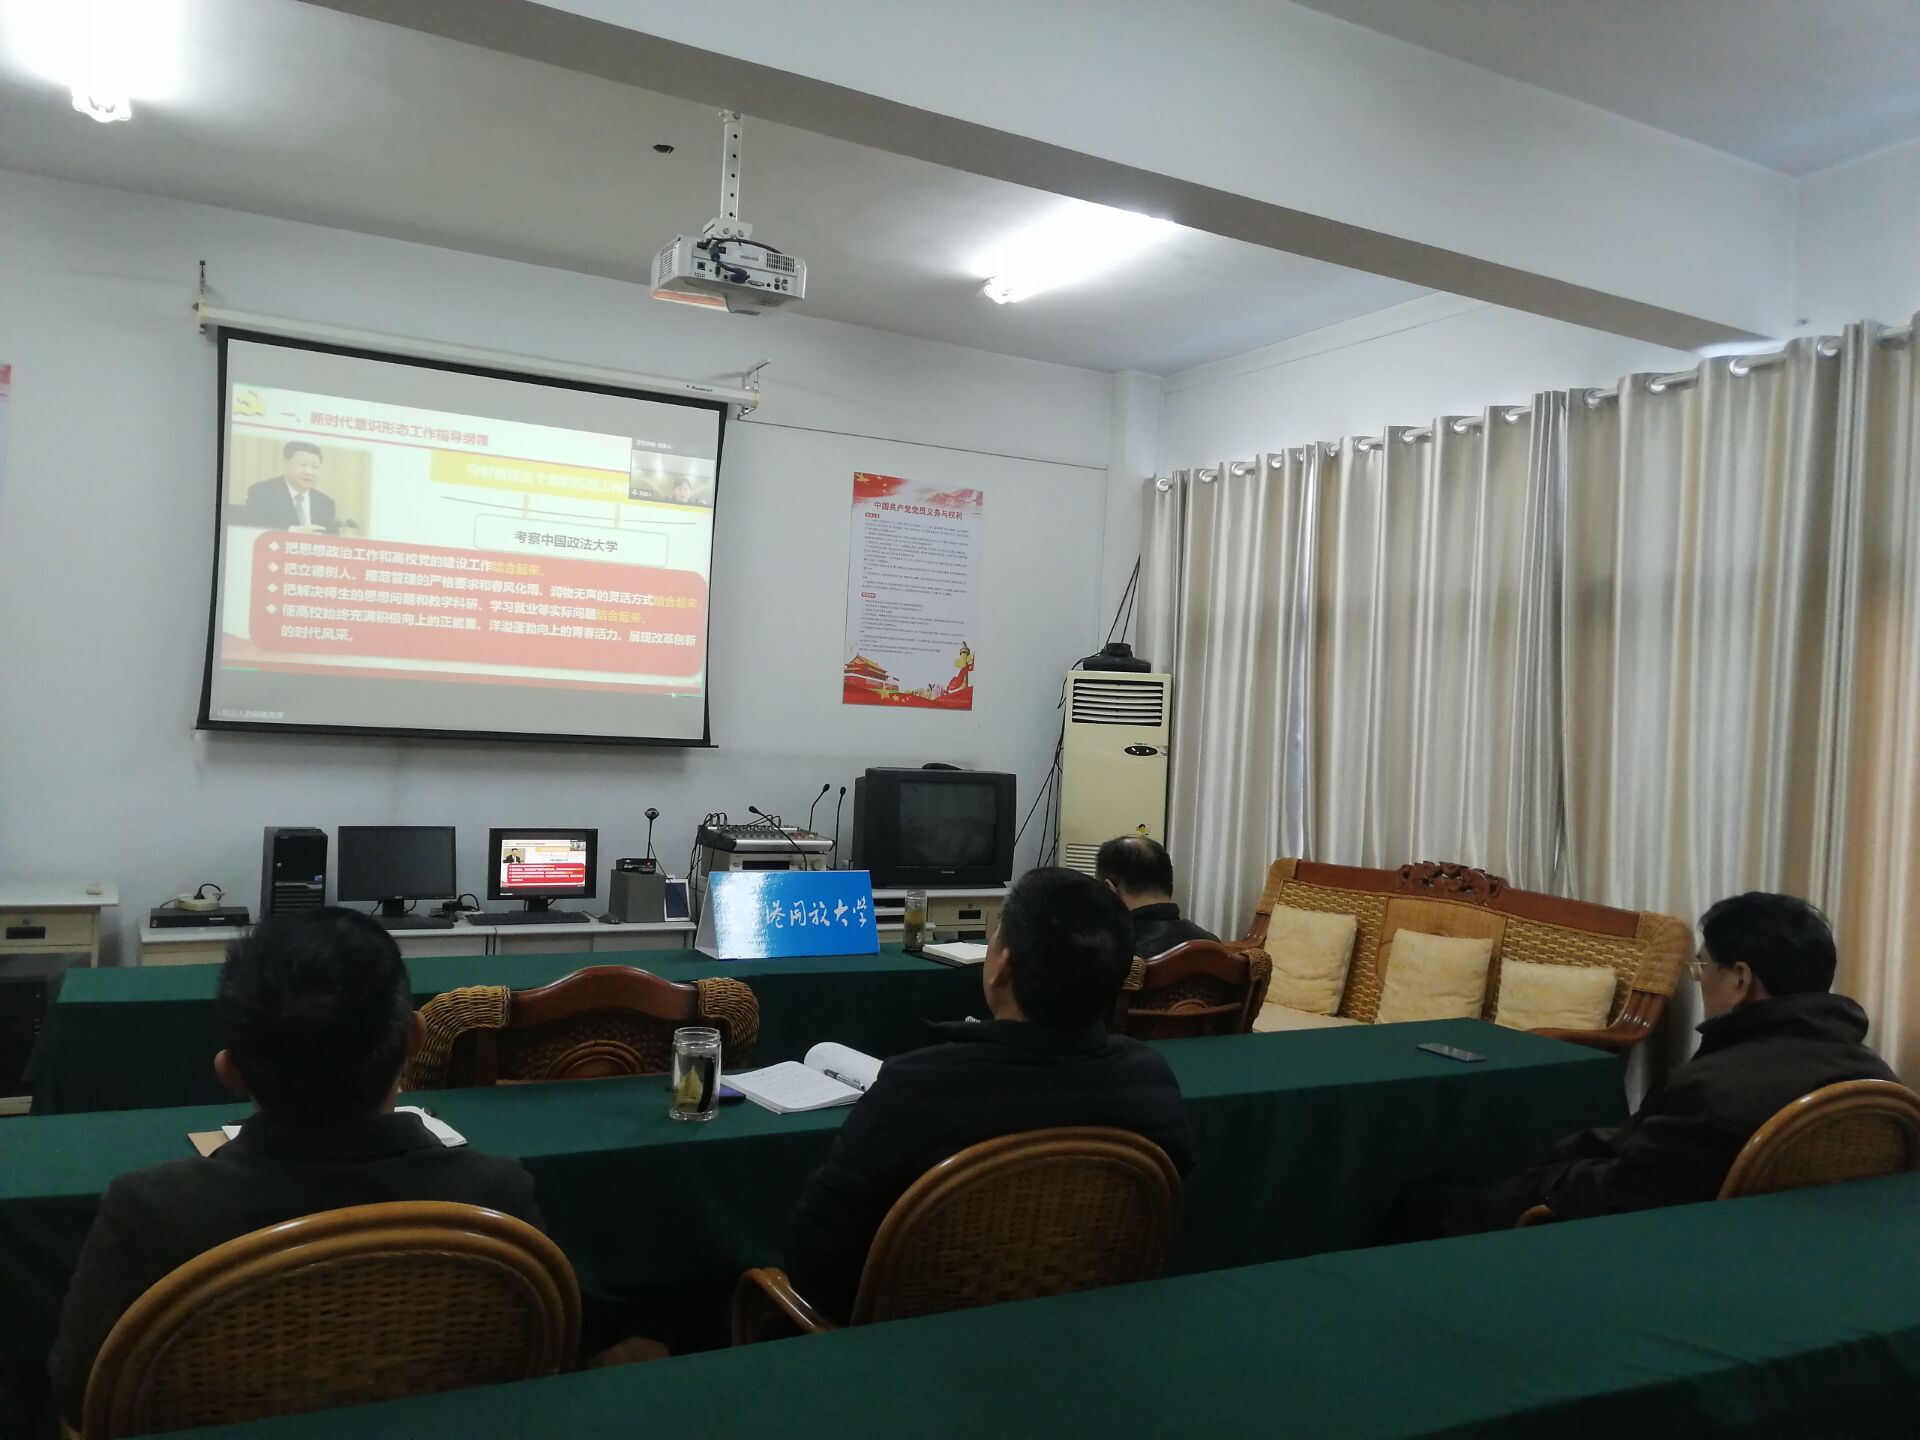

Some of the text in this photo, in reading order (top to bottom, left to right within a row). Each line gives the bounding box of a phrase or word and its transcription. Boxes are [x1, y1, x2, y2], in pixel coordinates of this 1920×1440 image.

[874, 501, 963, 520] 中国共产党党员义务与权利
[514, 530, 619, 553] 考察中国政法大学
